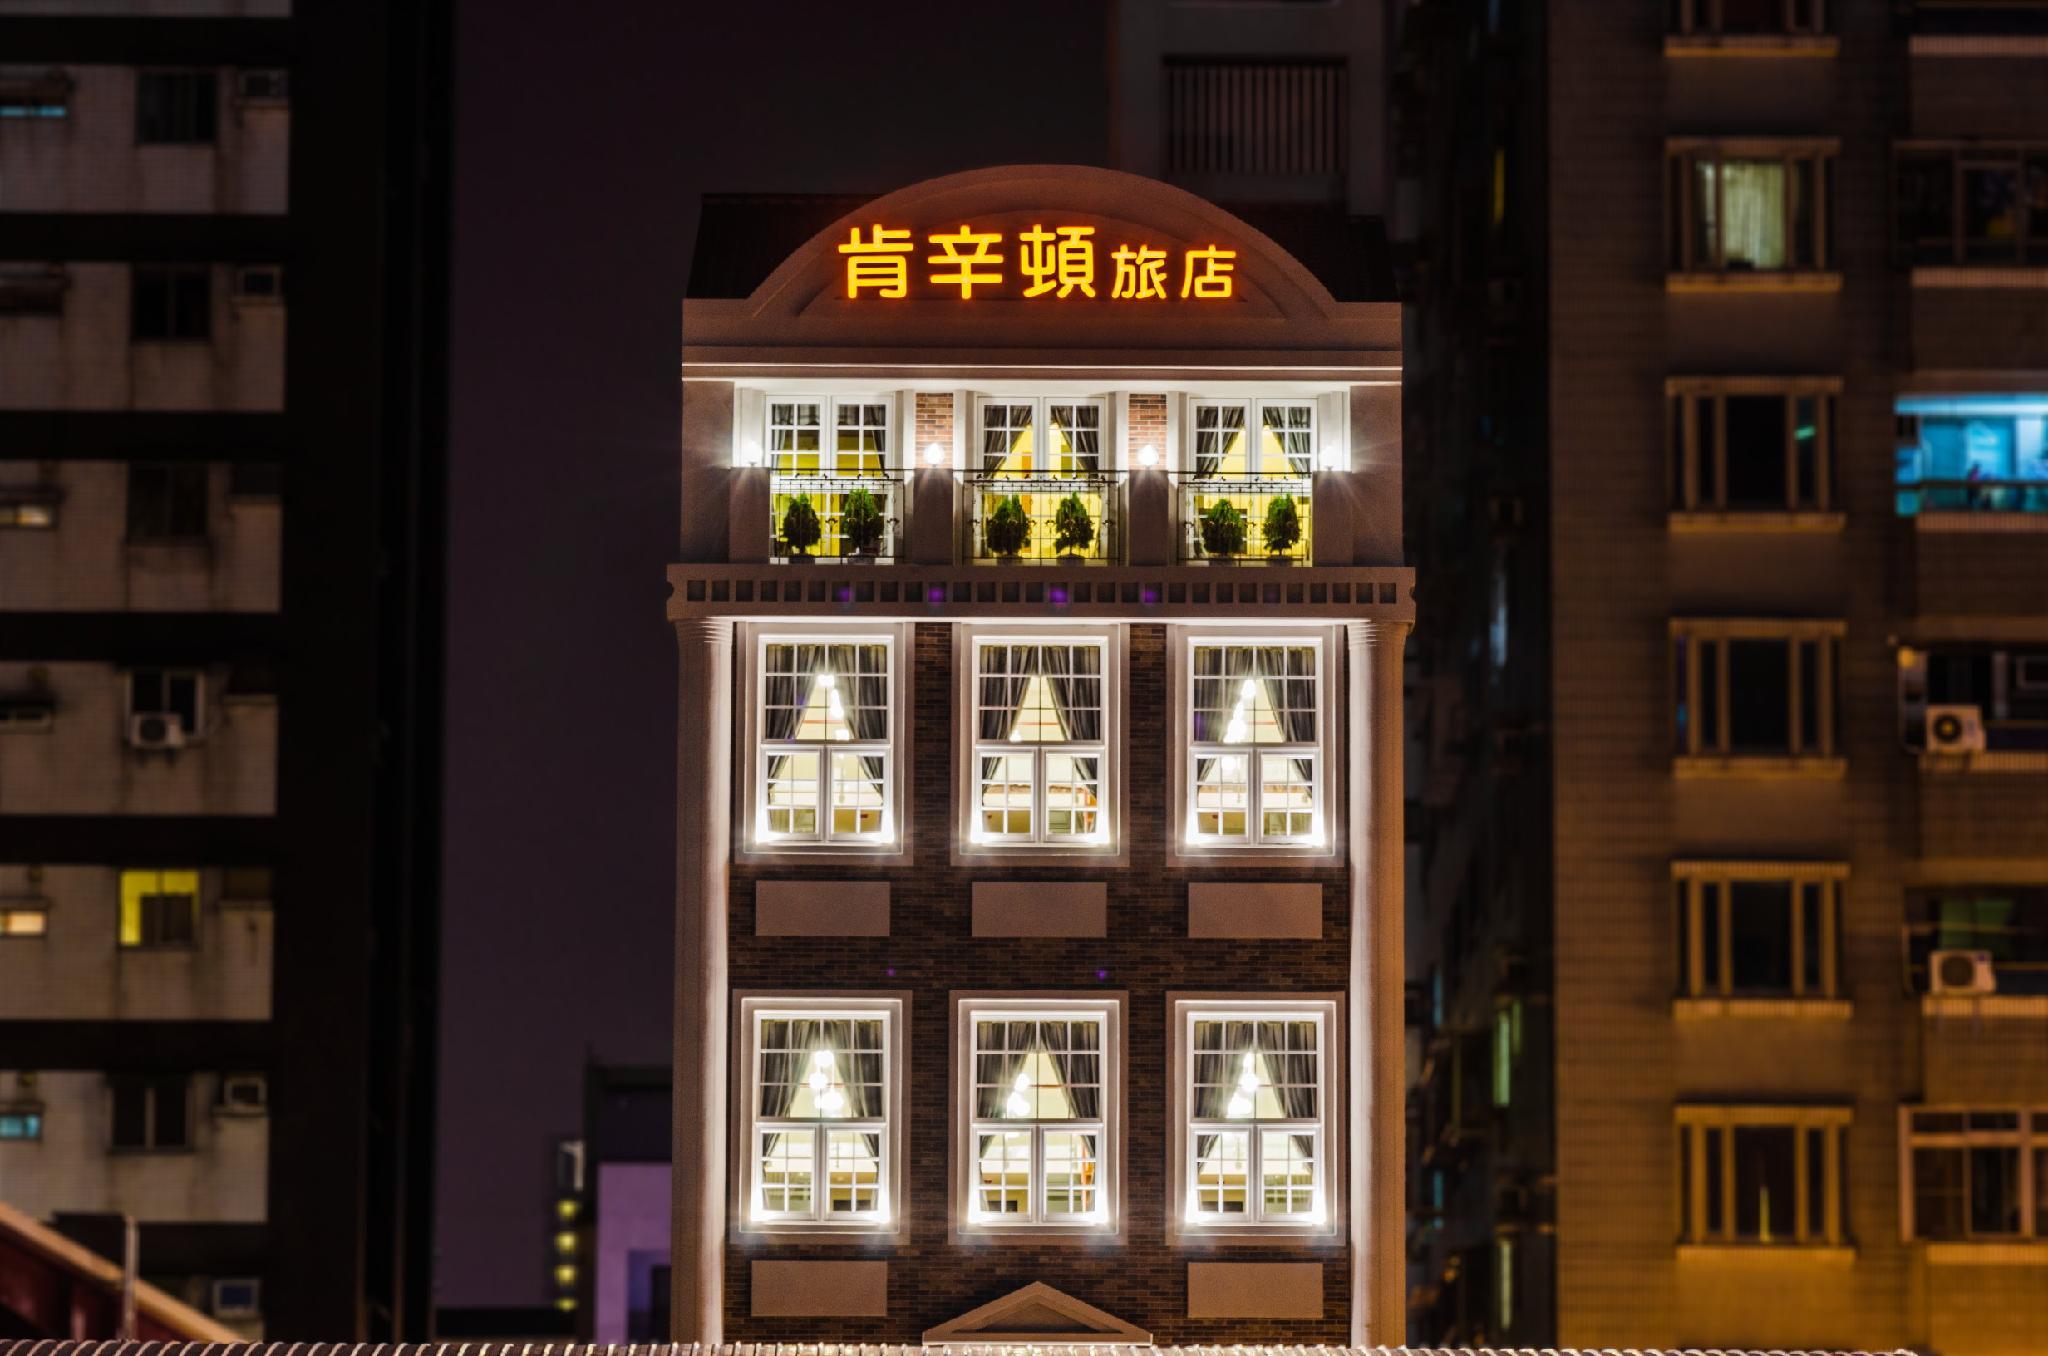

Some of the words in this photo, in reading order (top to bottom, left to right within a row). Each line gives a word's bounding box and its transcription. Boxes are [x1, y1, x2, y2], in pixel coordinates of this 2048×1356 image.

[837, 223, 1237, 299] 肯辛頓旅店
